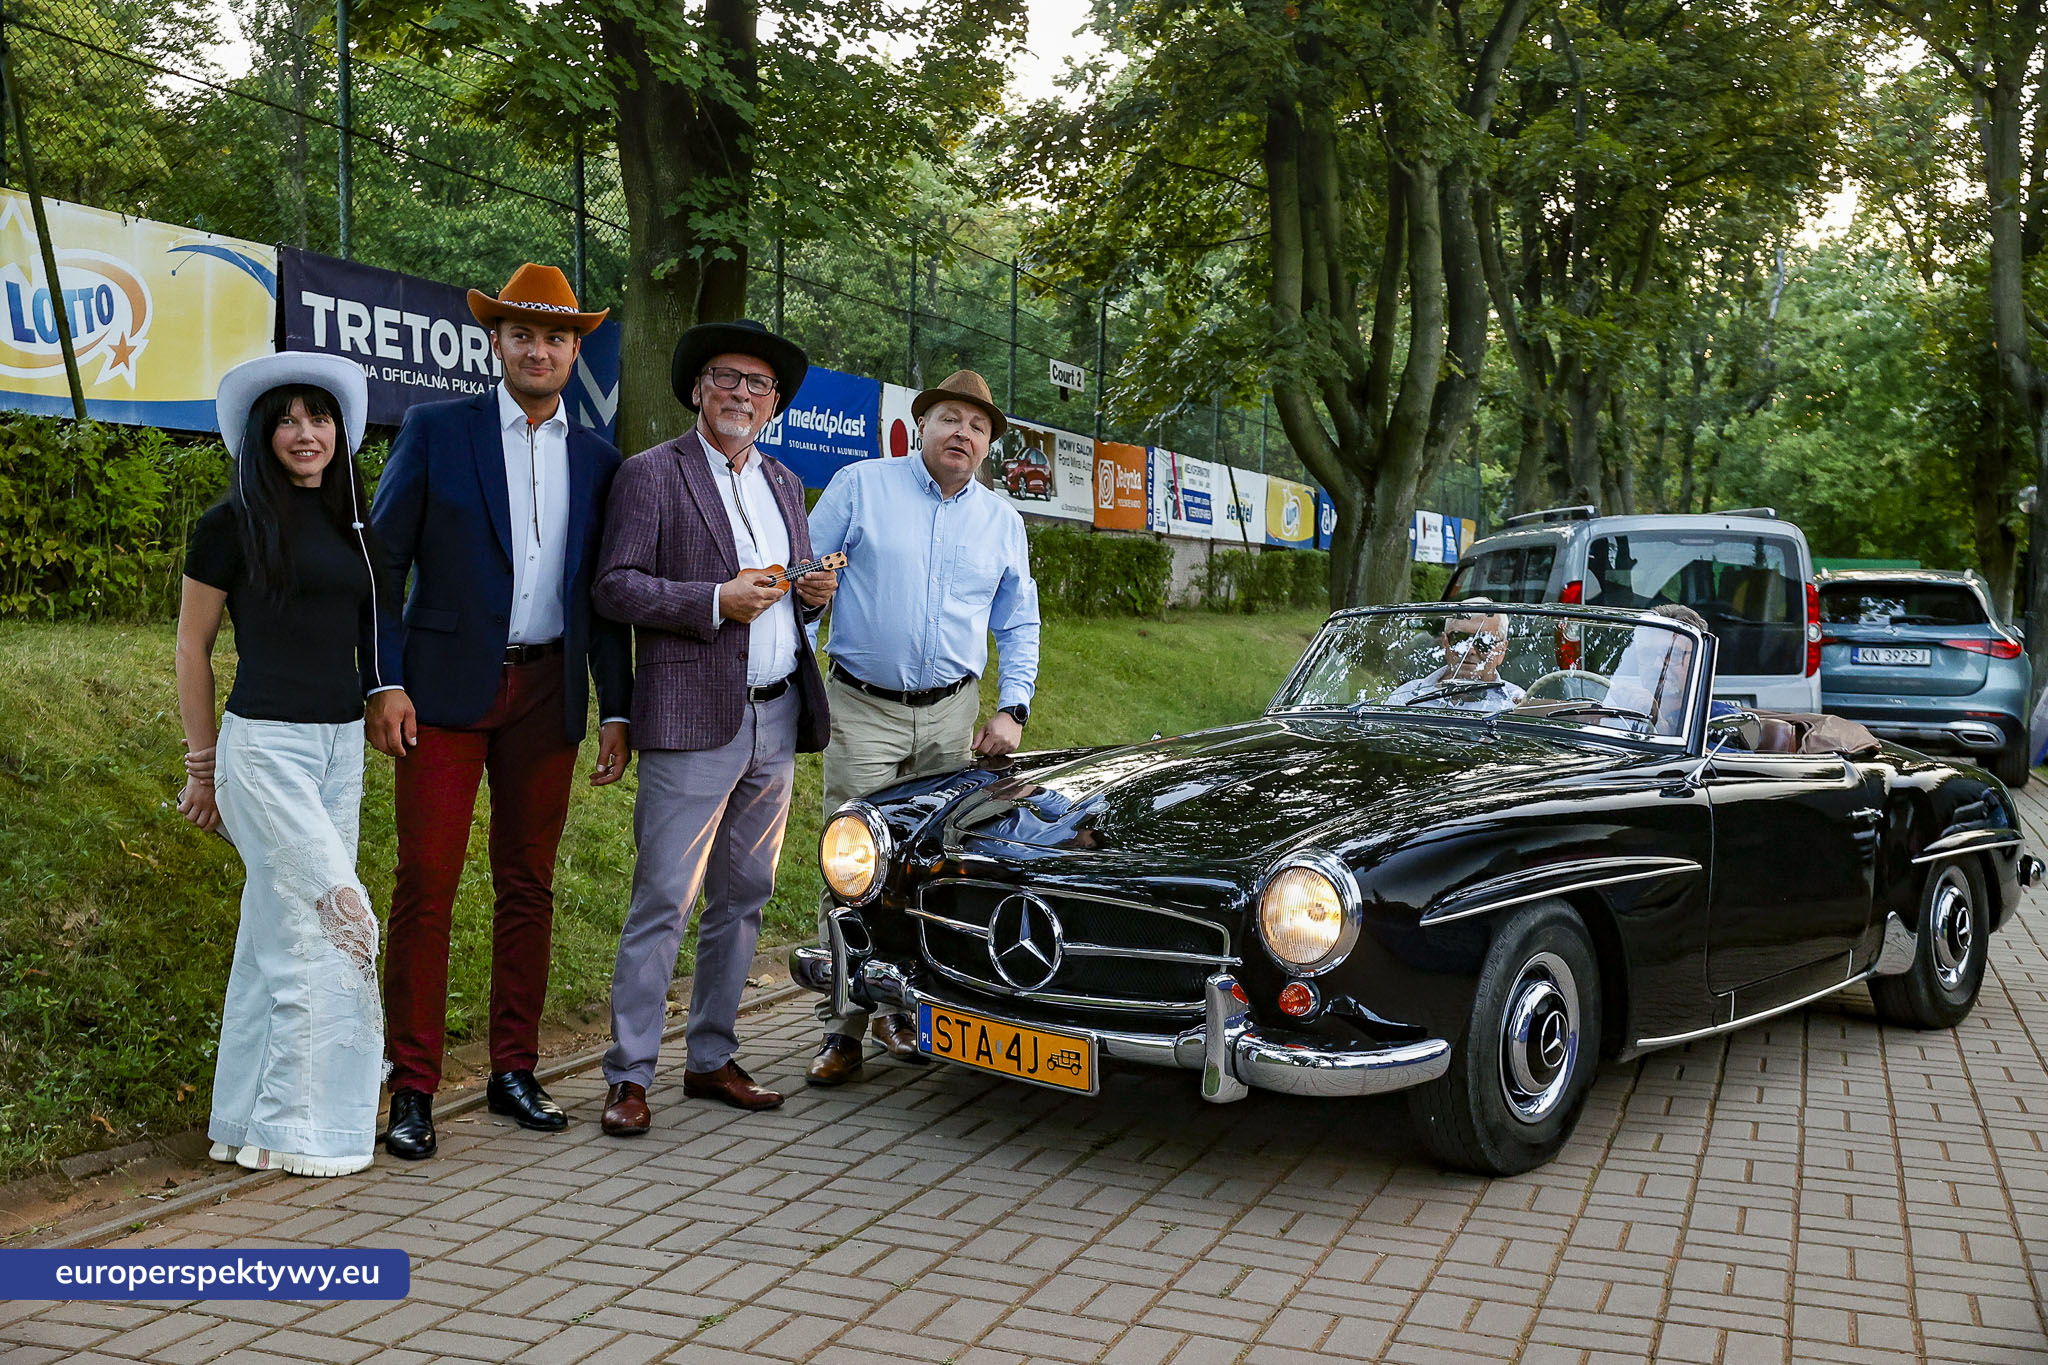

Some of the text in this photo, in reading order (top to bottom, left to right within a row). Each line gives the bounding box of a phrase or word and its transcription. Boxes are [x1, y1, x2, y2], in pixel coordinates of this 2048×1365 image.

[5, 280, 114, 344] LOTTO
[383, 366, 450, 390] OFICJALNA
[452, 378, 486, 395] PIŁKA
[1052, 363, 1082, 388] Court 2
[788, 405, 866, 439] metalplast
[788, 439, 818, 451] STOLARKA
[819, 443, 830, 454] PCV
[837, 446, 869, 458] ALUMINIUM
[1076, 442, 1093, 456] SALON
[1861, 648, 1926, 663] KN 3925J
[921, 1032, 931, 1044] PL
[935, 1014, 1039, 1074] STA 4J
